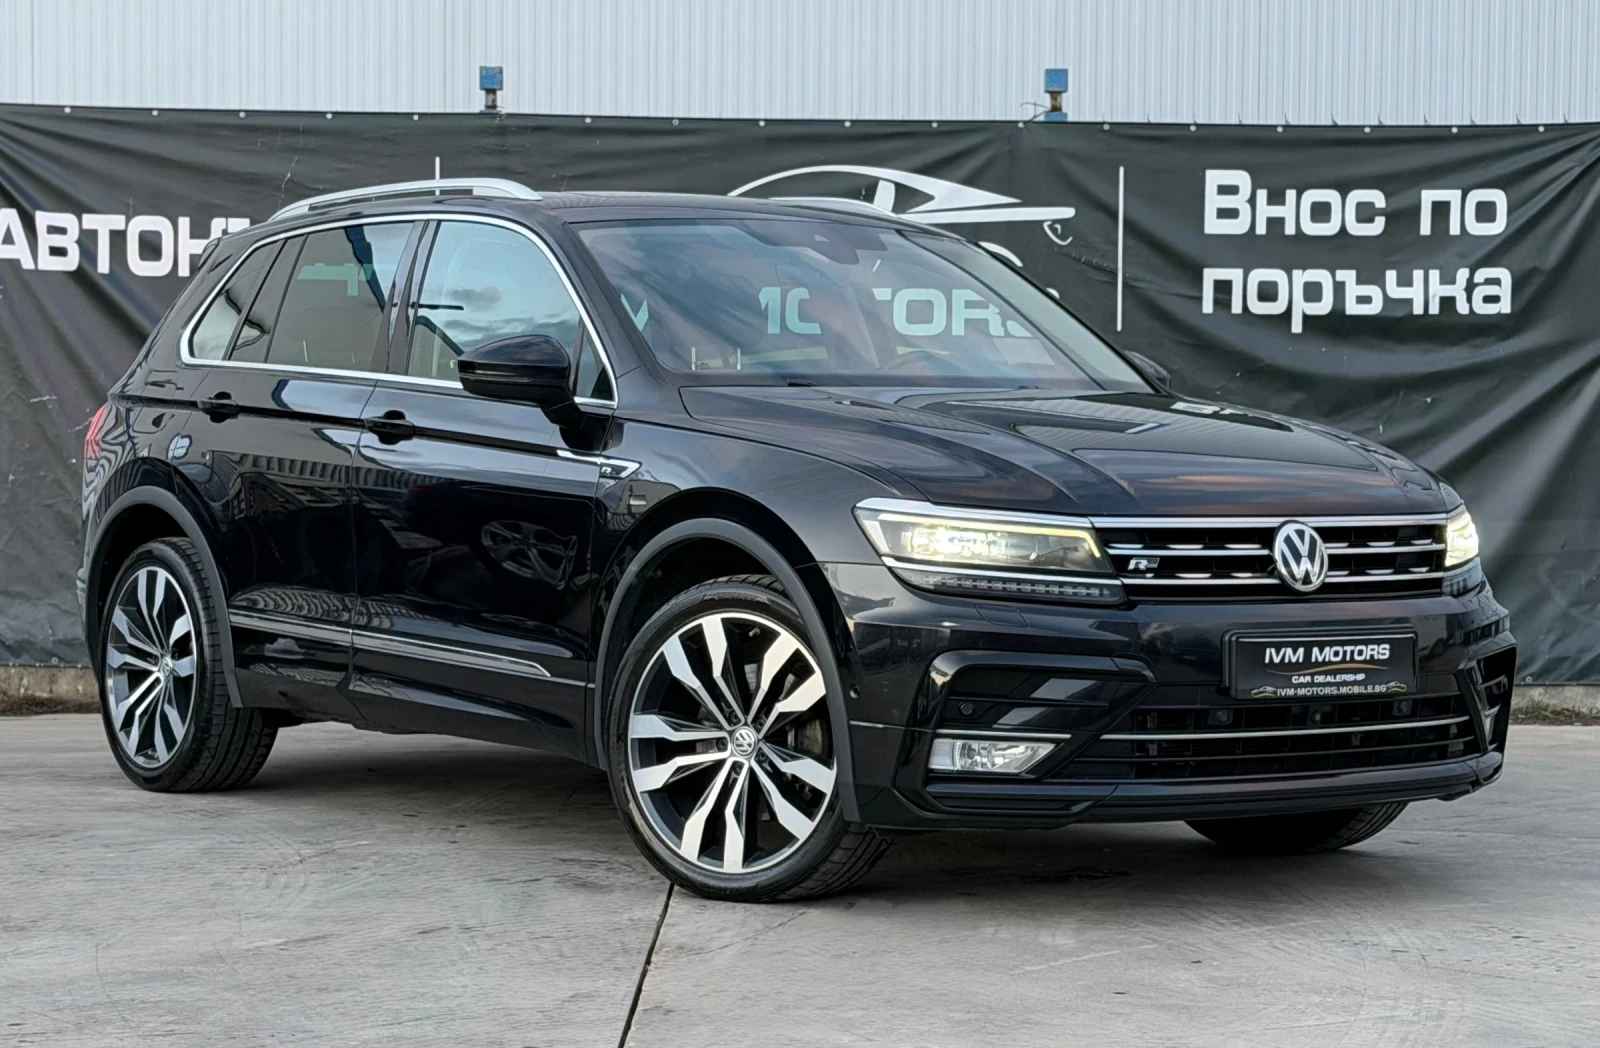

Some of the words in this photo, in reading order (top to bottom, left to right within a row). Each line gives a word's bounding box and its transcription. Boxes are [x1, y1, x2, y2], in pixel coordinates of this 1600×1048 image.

[1203, 169, 1386, 236] Внос
[1419, 188, 1508, 236] по
[1202, 267, 1512, 334] поръчка
[1264, 647, 1304, 664] IVM
[1311, 644, 1390, 663] MOTORS
[1291, 675, 1311, 684] CAR
[1313, 673, 1366, 683] DEALERSHIP
[1277, 685, 1387, 697] IVM-MOTORS.MOBILE.BG
